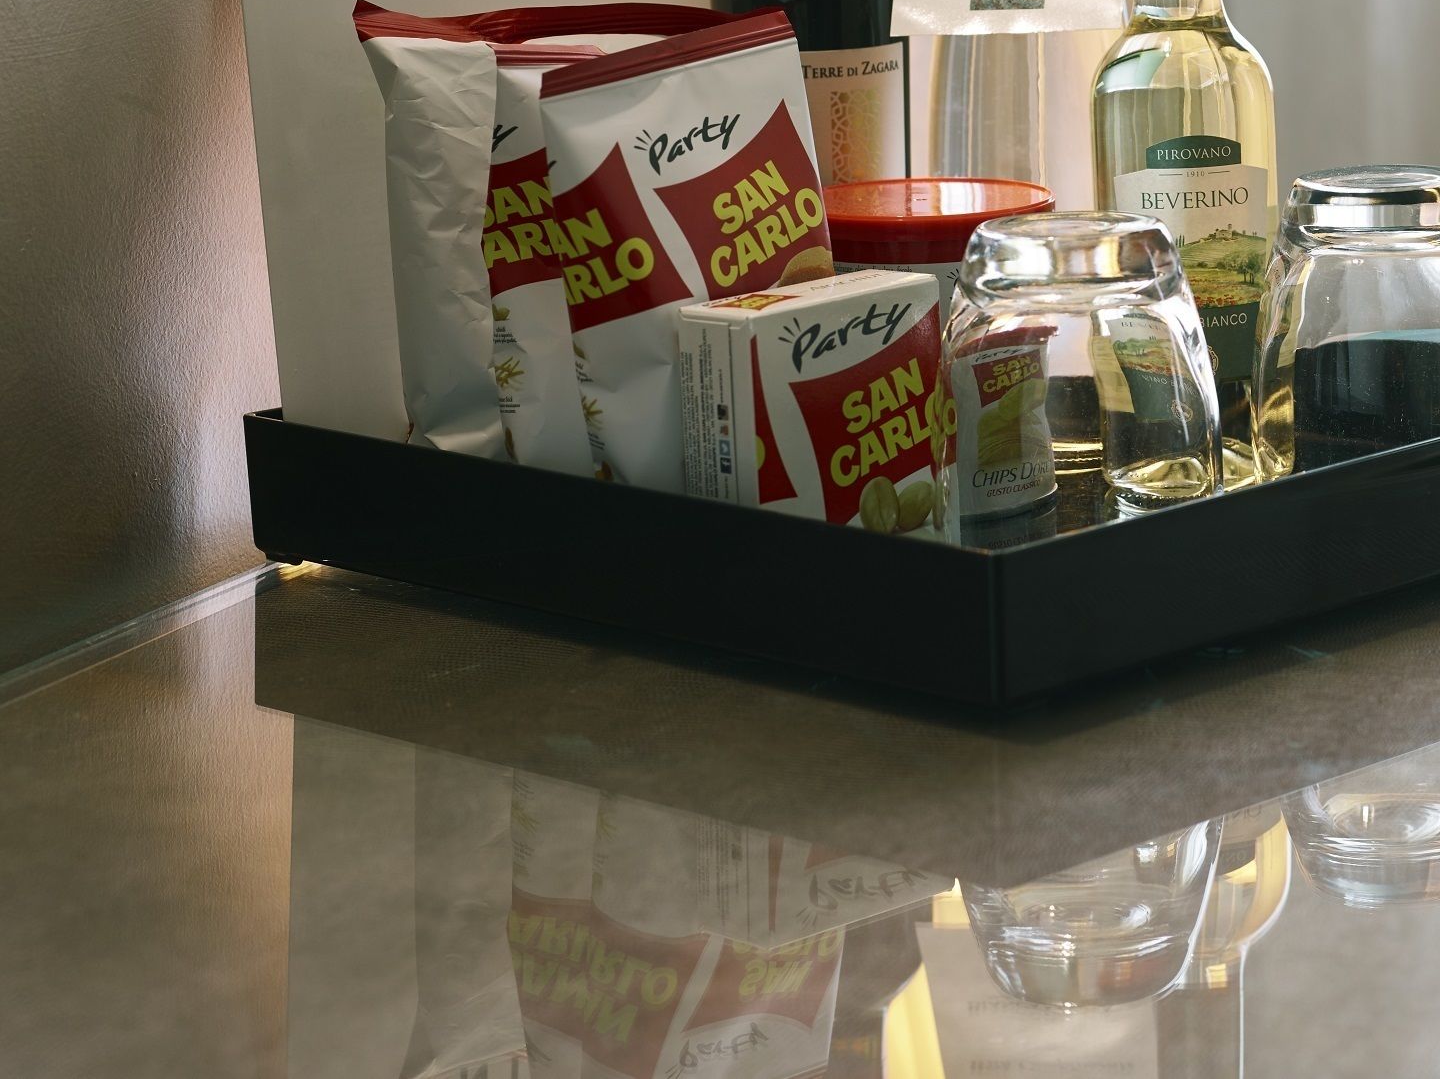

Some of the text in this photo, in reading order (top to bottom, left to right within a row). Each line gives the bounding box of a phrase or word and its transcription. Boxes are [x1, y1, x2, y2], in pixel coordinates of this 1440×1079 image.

[802, 60, 900, 79] TERRE DI ZAGARA
[649, 114, 741, 176] Party
[1157, 145, 1231, 161] PIROVANO
[484, 176, 553, 228] AN
[713, 160, 790, 235] SAN
[1141, 187, 1249, 210] BEVERINO
[554, 208, 613, 261] AN
[710, 188, 824, 287] CARLO
[563, 237, 655, 306] RLO
[791, 302, 912, 374] Party
[983, 362, 1040, 393] CARLO
[992, 356, 1032, 376] SAN
[842, 358, 925, 434] SAN
[972, 467, 1018, 488] CHIPS
[986, 479, 1041, 498] GUSTO CLASSICO
